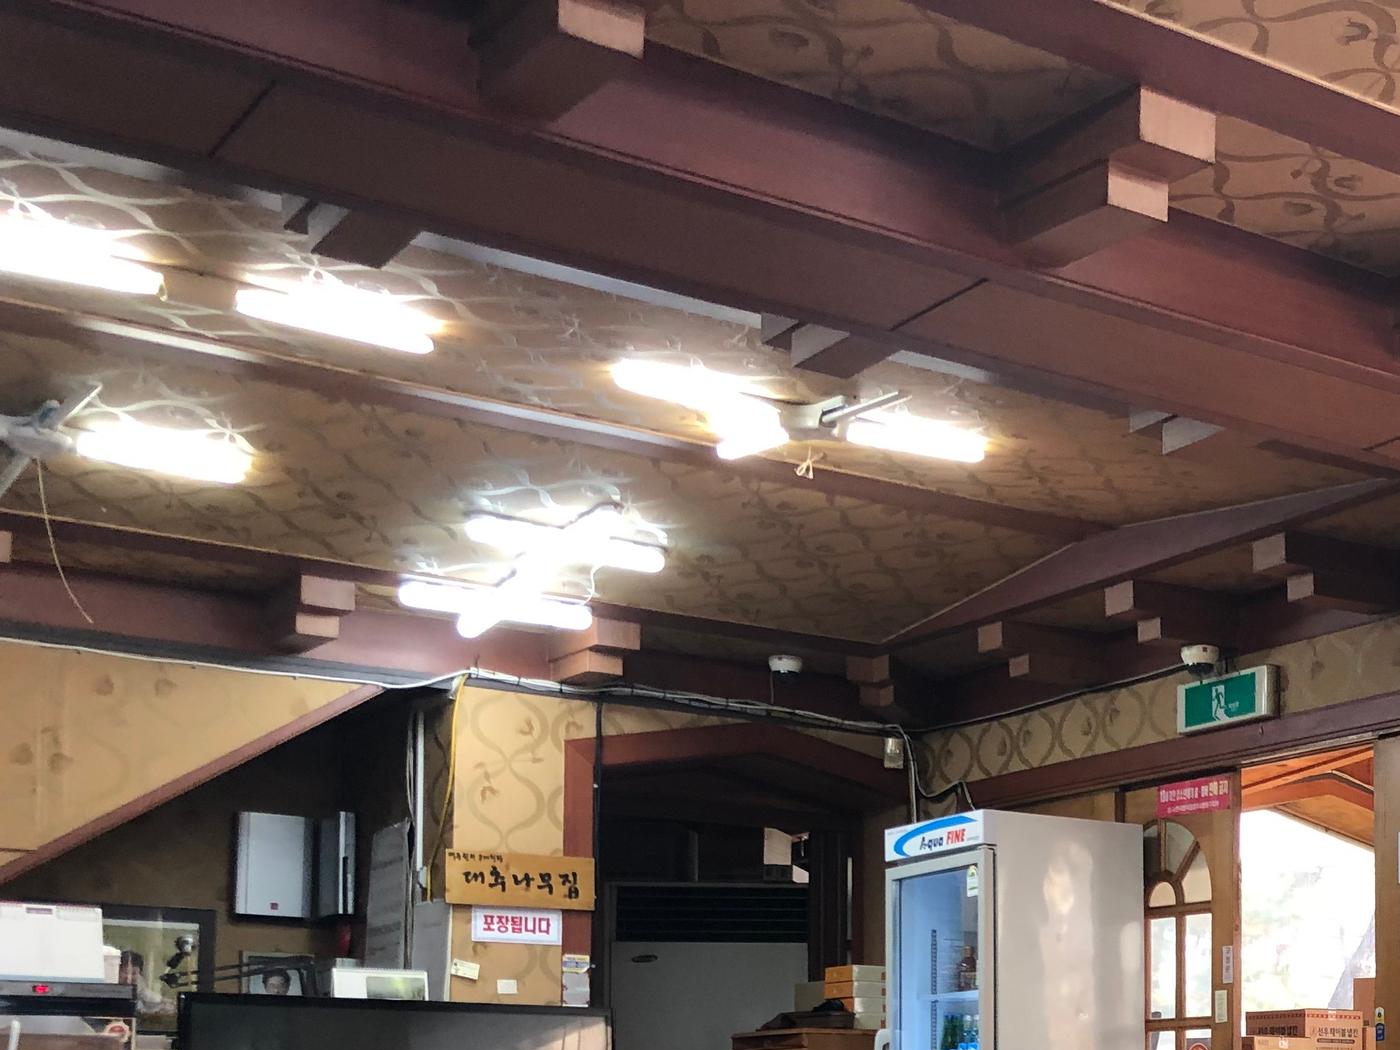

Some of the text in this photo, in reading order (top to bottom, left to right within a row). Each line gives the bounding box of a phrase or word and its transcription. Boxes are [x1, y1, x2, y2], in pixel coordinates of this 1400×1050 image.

[946, 828, 967, 845] FINE
[462, 865, 580, 900] 대추나무집
[482, 914, 552, 935] 포장됩니다
